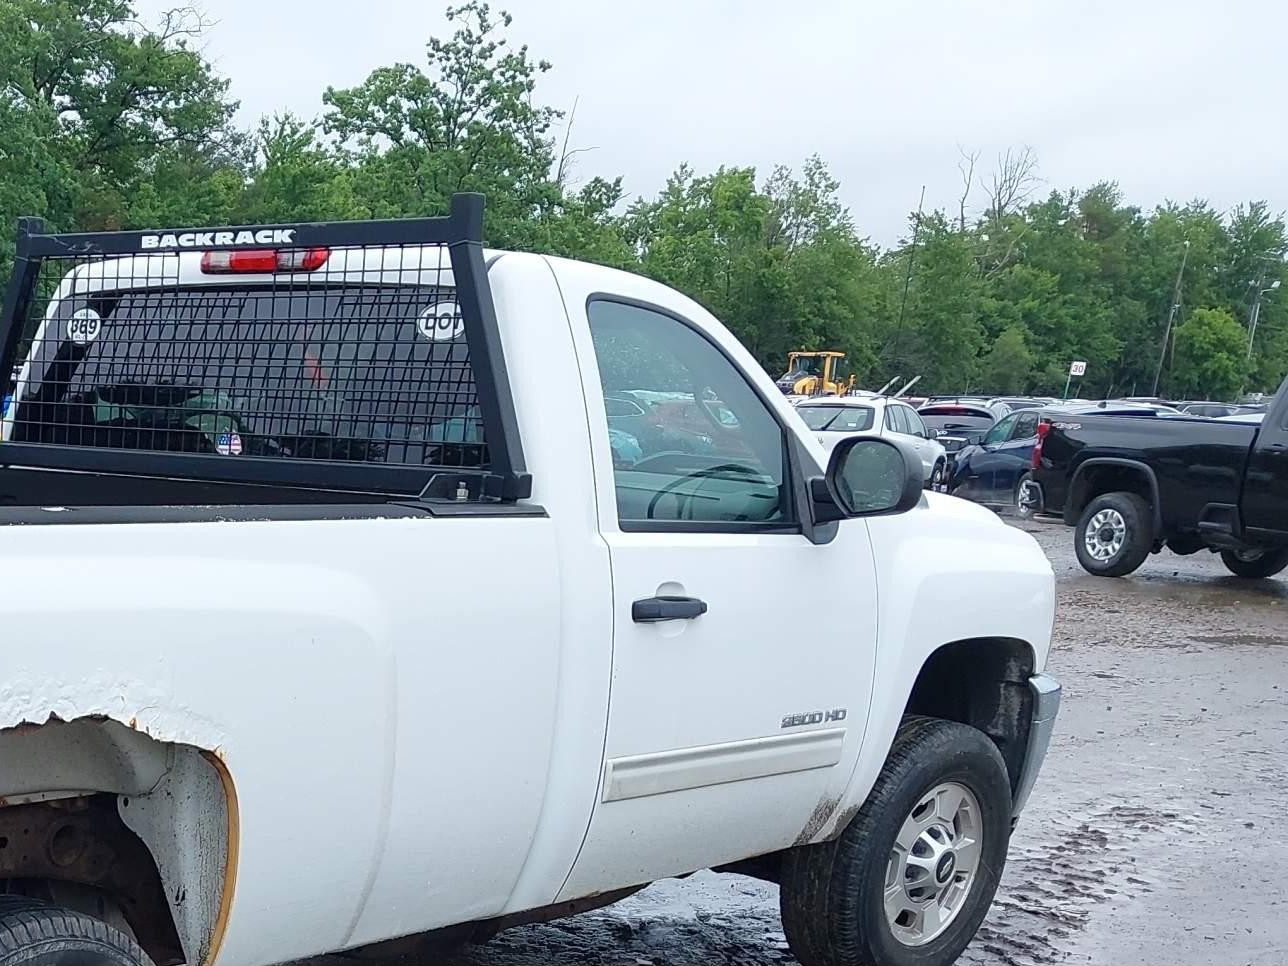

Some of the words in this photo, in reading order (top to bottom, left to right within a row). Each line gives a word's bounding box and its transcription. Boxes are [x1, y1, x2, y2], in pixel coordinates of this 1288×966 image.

[141, 229, 294, 249] BACKRACK
[72, 319, 98, 335] 369
[1072, 364, 1084, 374] 30
[824, 709, 847, 721] HD
